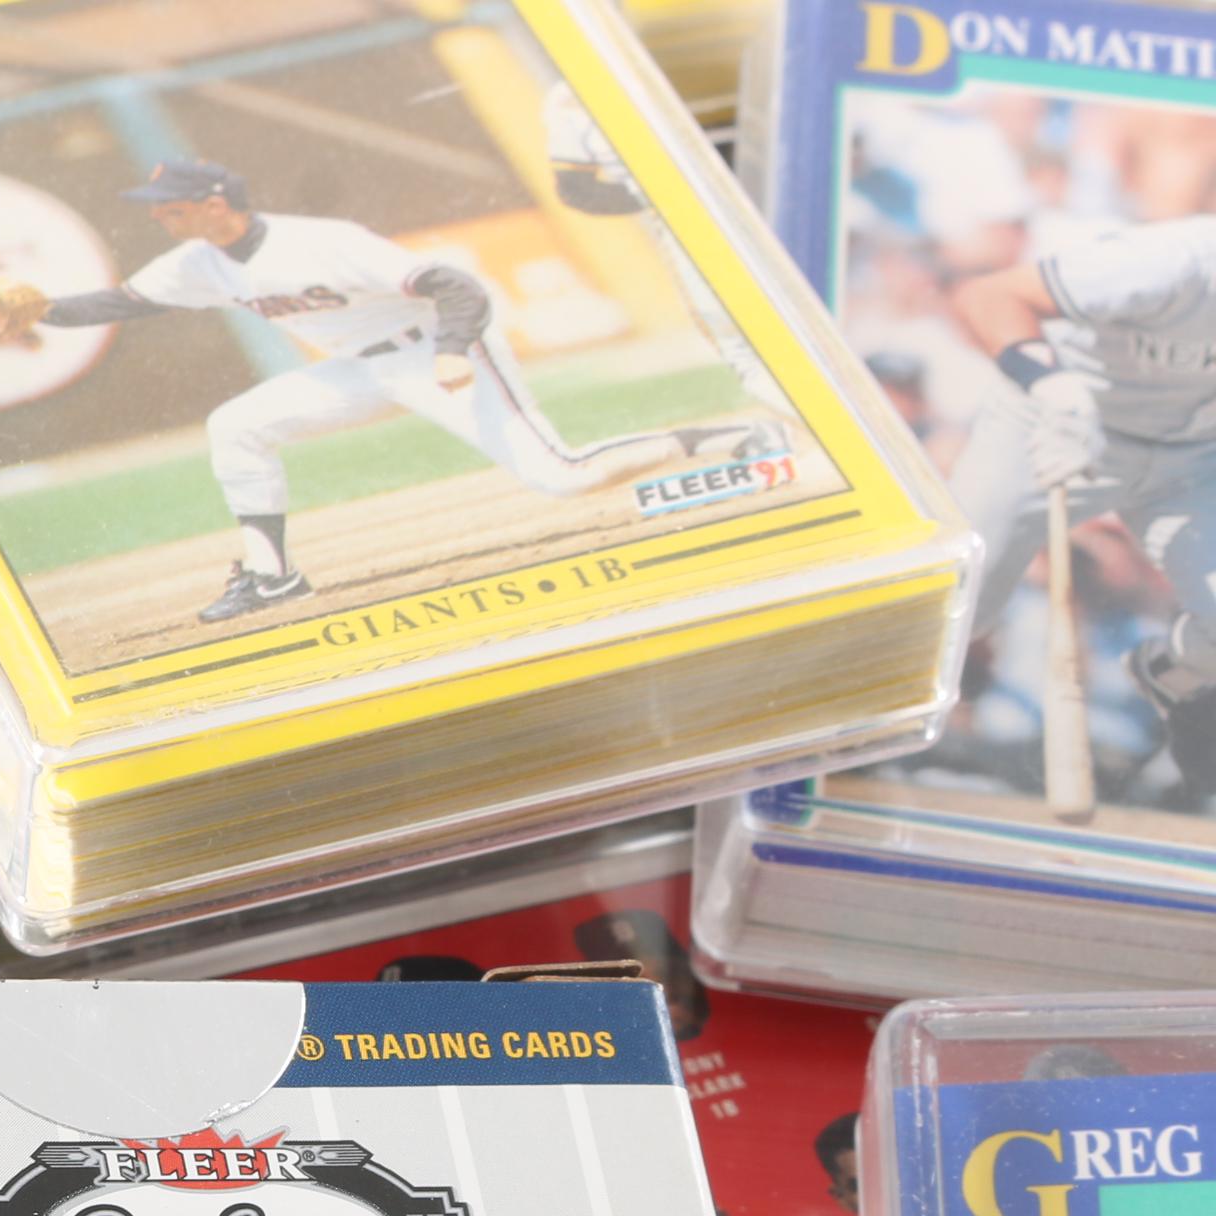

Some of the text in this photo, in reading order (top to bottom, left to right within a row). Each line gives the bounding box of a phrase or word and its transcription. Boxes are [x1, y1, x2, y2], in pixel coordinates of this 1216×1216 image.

[855, 2, 1216, 78] DON MATTI
[636, 464, 754, 507] FLEER
[322, 557, 631, 647] GIANTS 1B
[335, 1032, 492, 1060] TRADING
[502, 1031, 616, 1058] CARDS
[685, 1050, 725, 1075] ONY
[689, 1072, 746, 1099] LARK
